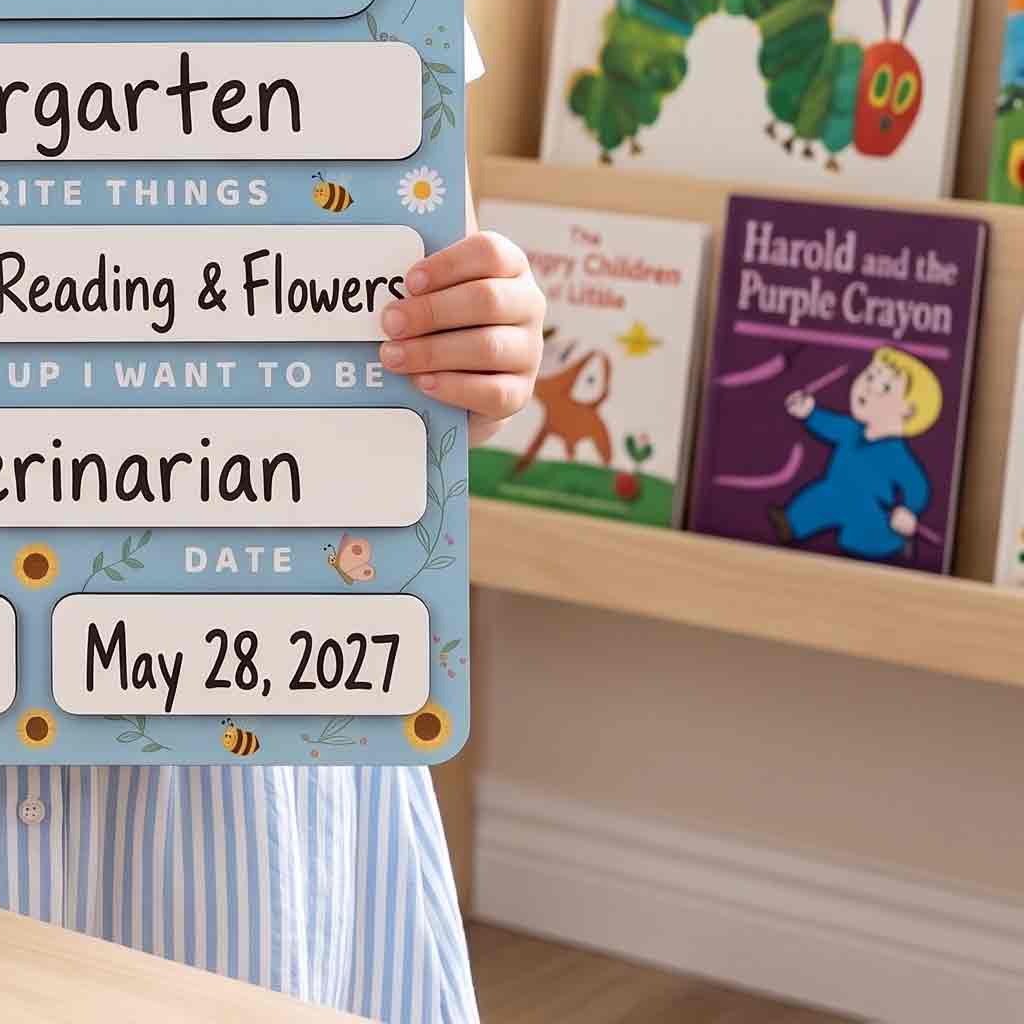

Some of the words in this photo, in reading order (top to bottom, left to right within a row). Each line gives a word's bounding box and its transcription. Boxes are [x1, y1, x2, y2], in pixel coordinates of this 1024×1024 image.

[105, 180, 269, 208] THINGS
[743, 219, 857, 275] Harold
[861, 246, 911, 281] and
[915, 250, 959, 286] the
[198, 262, 228, 313] &
[738, 268, 837, 327] Purple
[841, 280, 953, 341] Crayon
[8, 362, 62, 390] UP
[83, 362, 94, 389] I
[114, 362, 240, 389] WANT
[259, 362, 313, 389] TO
[335, 361, 385, 389] BE
[184, 546, 292, 574] DATE
[86, 621, 184, 713] May
[205, 629, 272, 698] 28,
[288, 631, 401, 694] 2027
